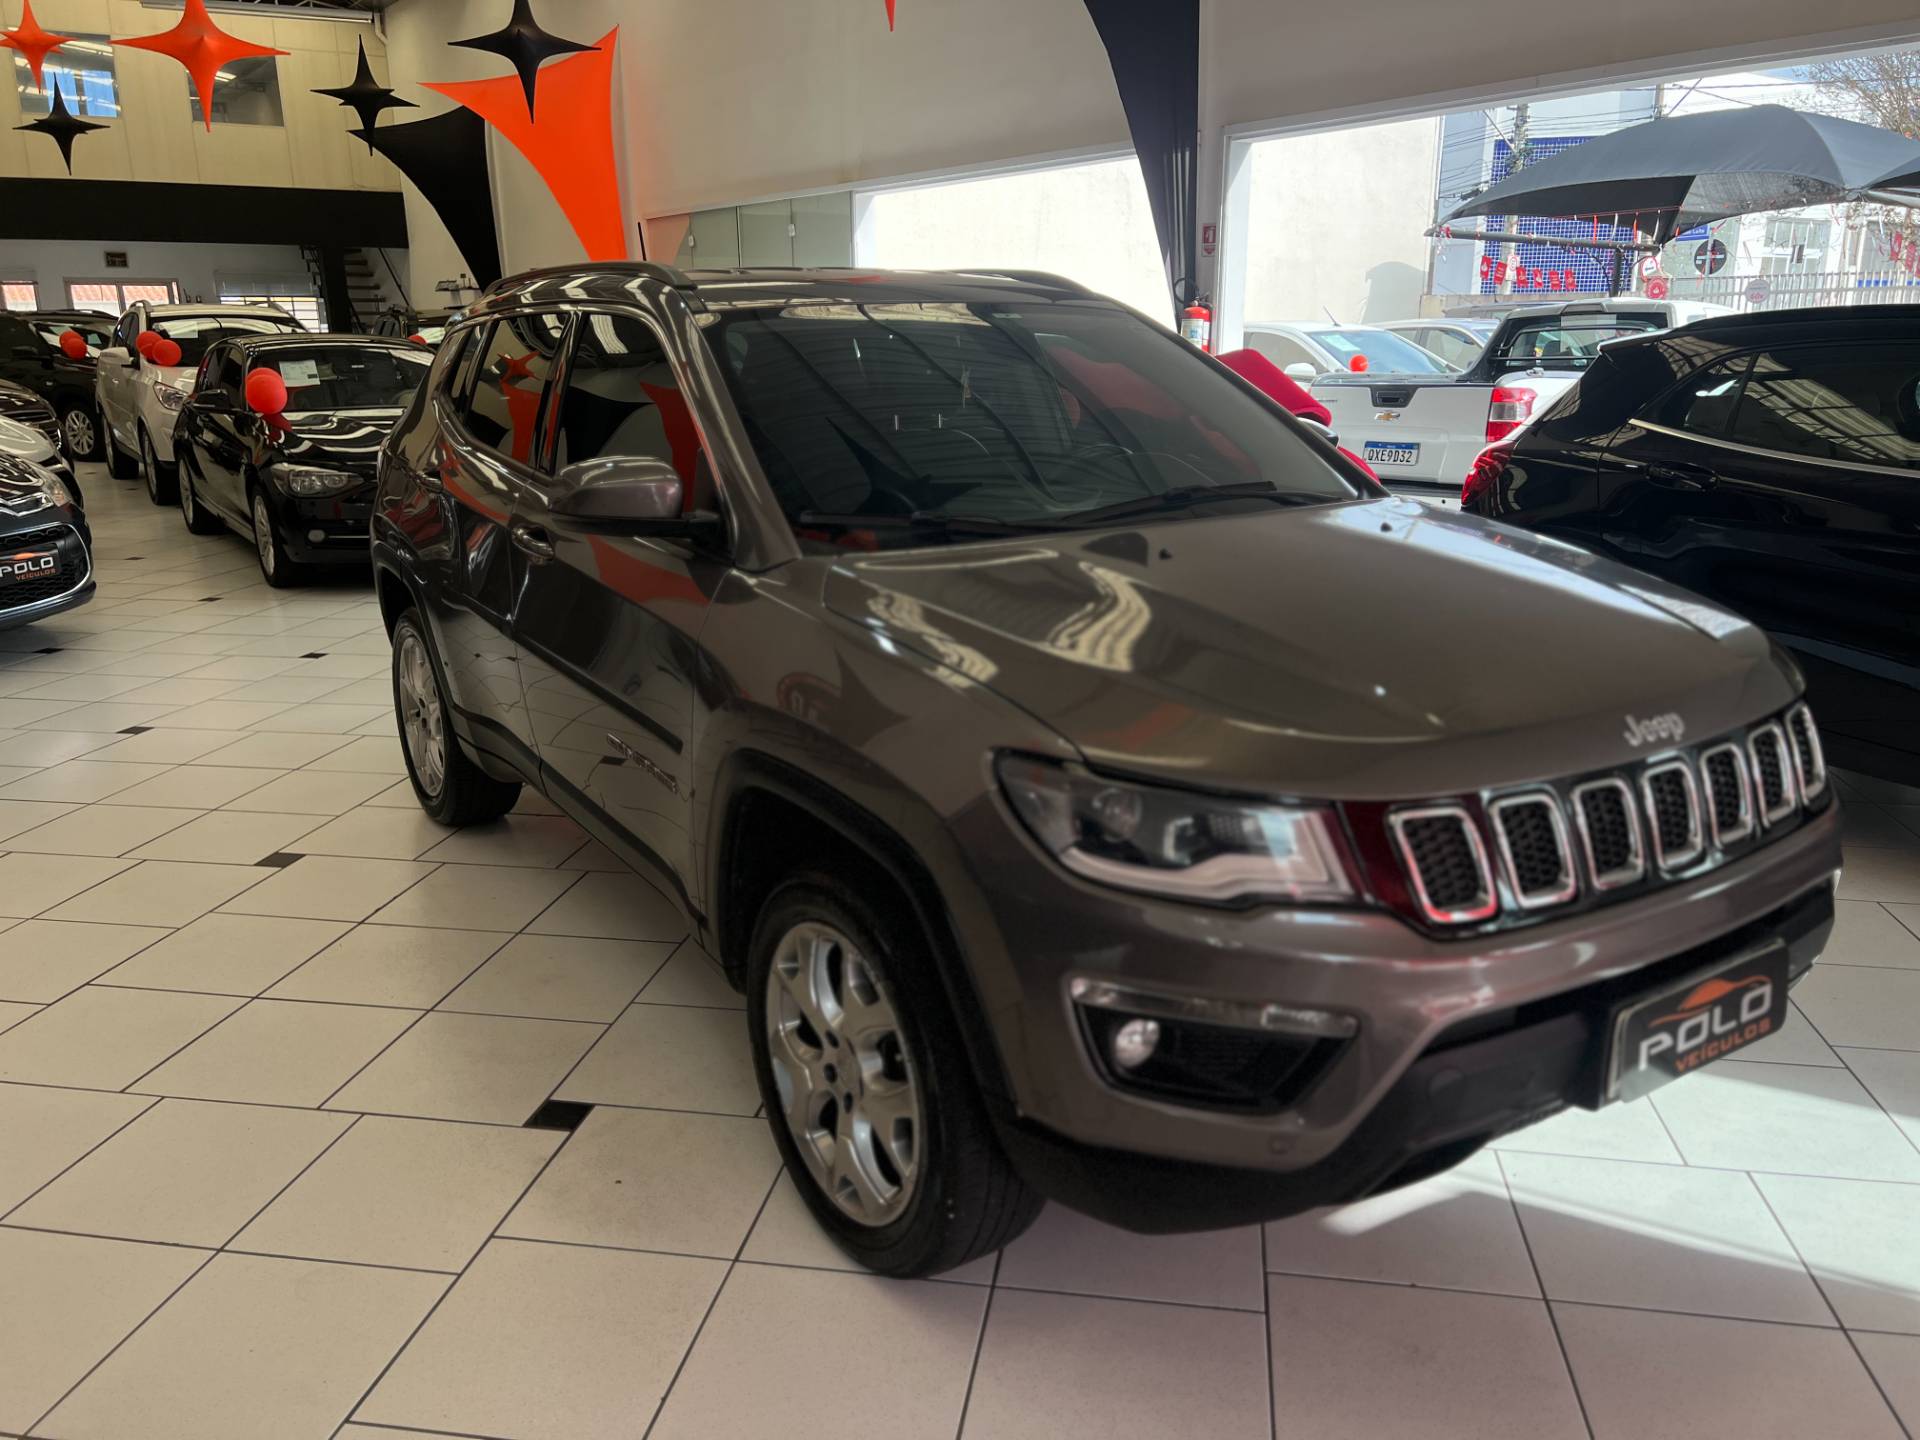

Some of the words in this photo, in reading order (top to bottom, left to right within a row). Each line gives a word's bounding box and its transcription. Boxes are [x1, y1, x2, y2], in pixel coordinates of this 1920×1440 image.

[0, 556, 54, 577] POLO
[1624, 712, 1685, 747] Jeep
[1638, 983, 1773, 1072] POLO
